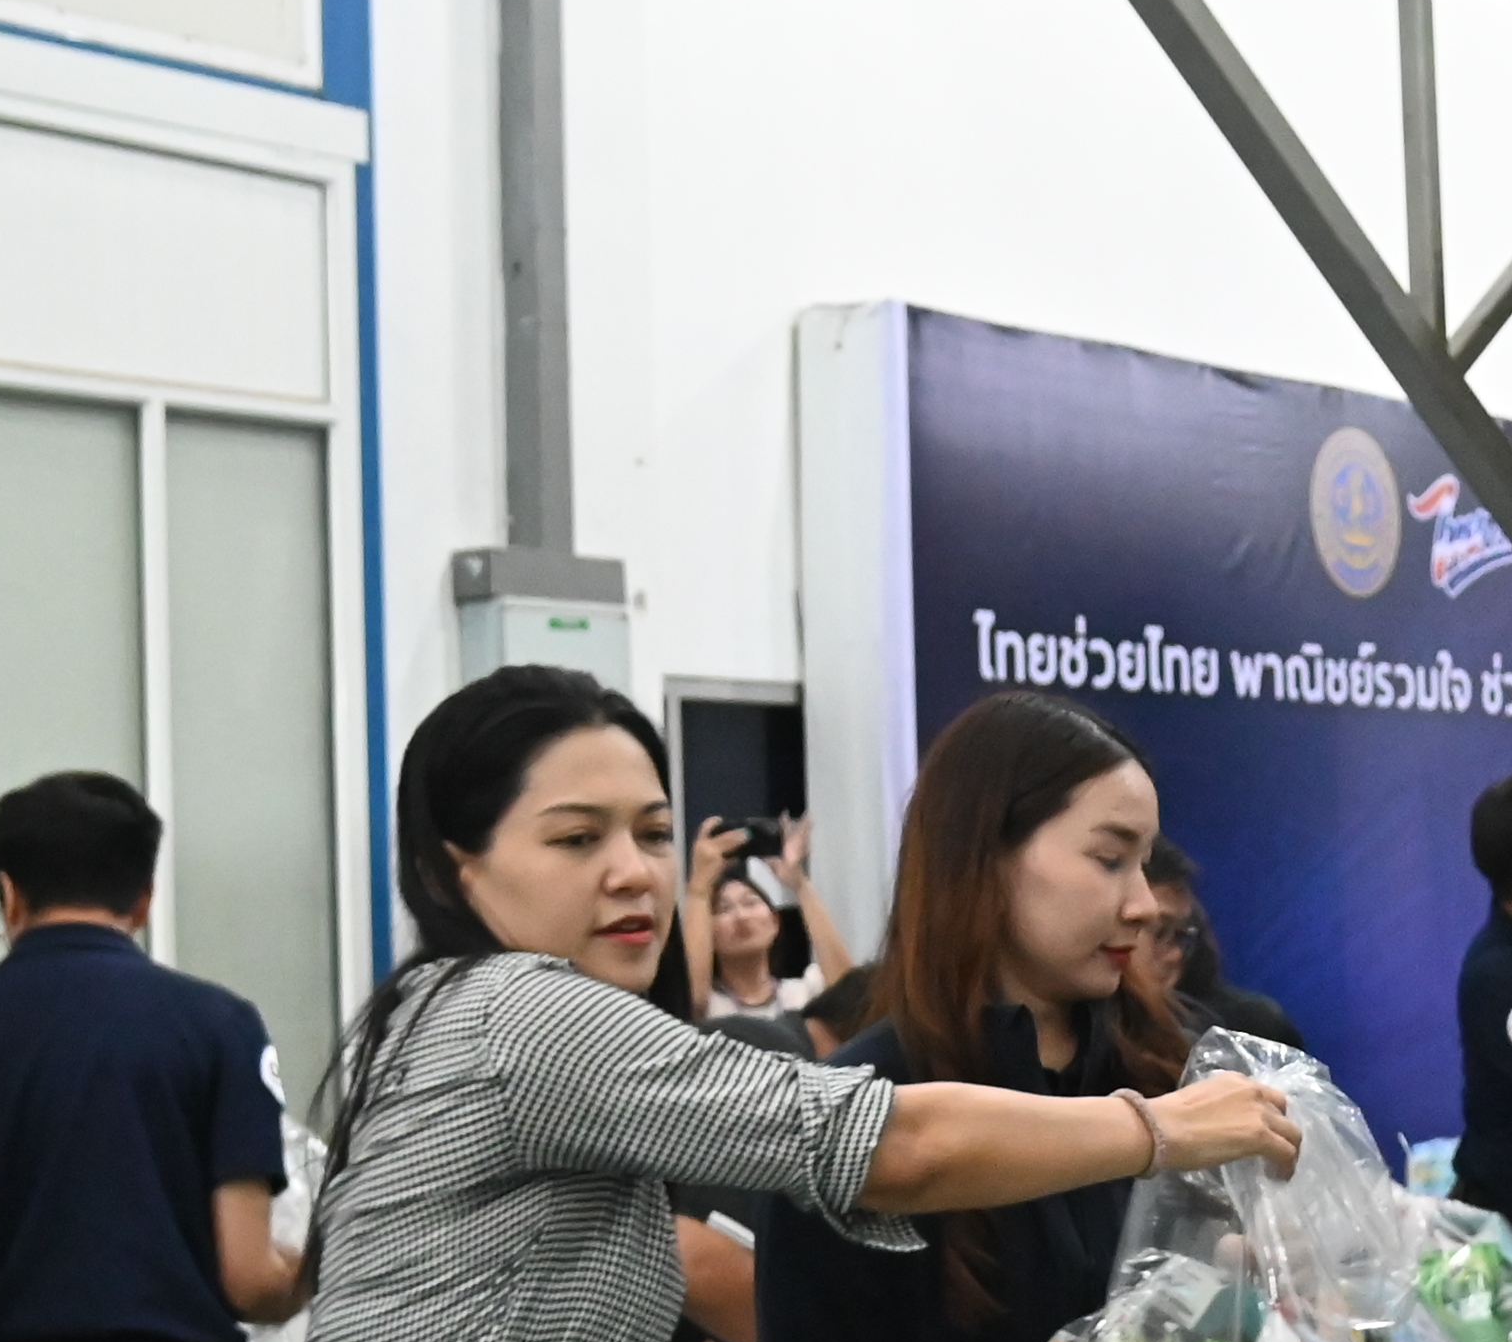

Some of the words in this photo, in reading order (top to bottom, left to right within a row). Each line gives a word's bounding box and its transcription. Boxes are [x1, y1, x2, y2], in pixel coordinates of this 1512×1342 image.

[972, 608, 1220, 698] ไทยช่วยไทย
[1229, 641, 1473, 713] พาณิชย์รวมใจ
